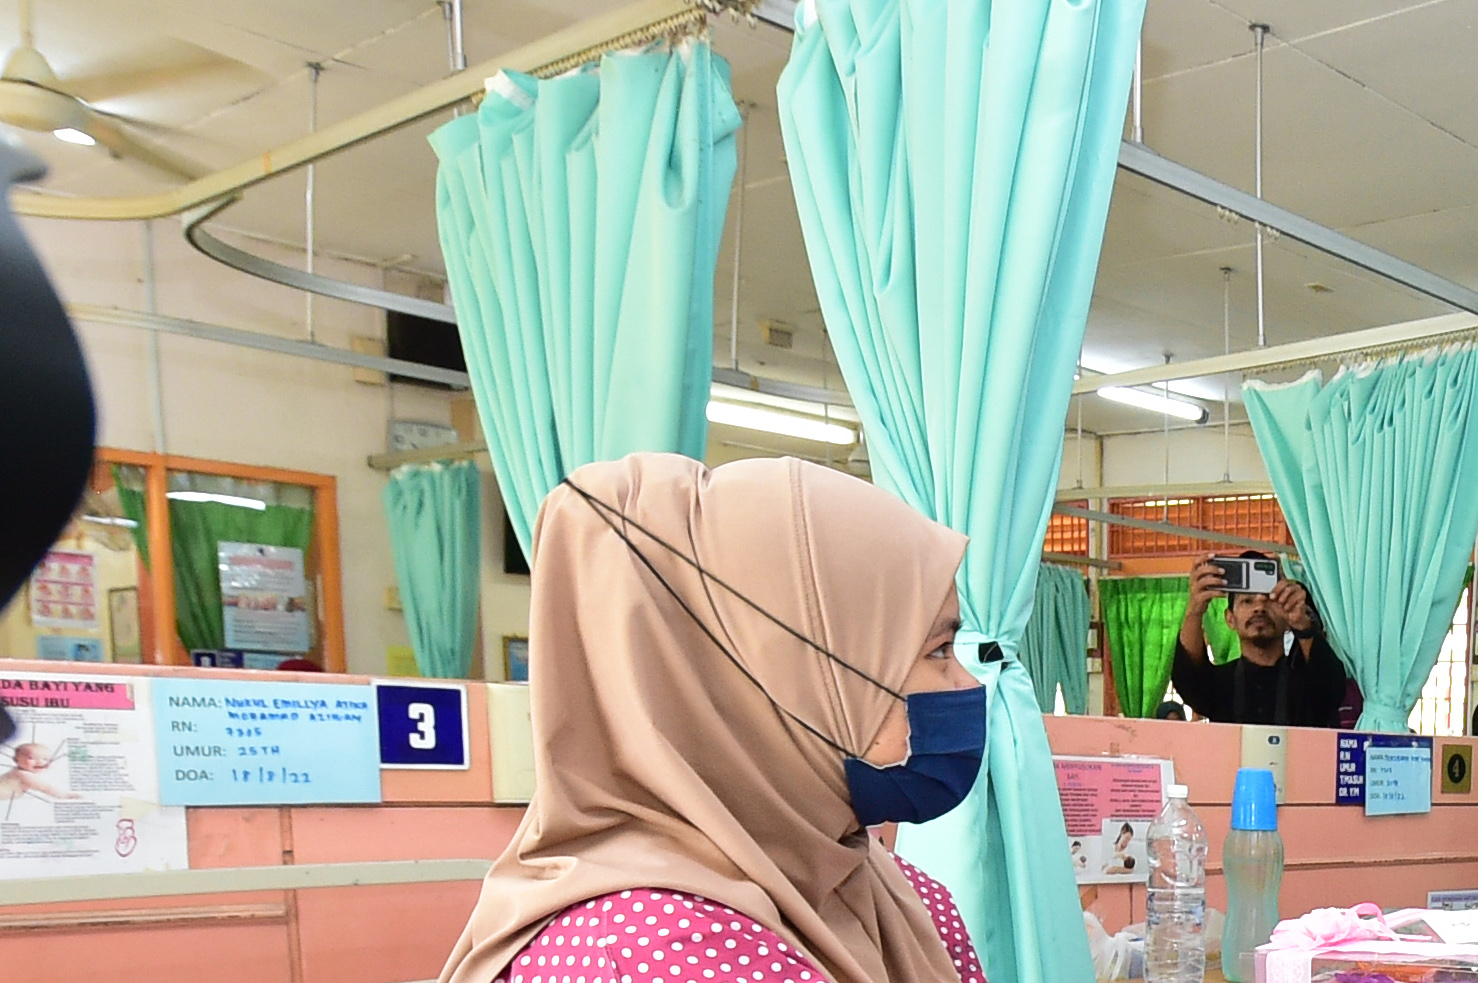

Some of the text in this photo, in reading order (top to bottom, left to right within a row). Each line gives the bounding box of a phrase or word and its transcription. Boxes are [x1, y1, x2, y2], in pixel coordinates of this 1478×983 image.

[29, 680, 67, 692] BAYI
[73, 681, 115, 694] YANG
[44, 699, 70, 709] IBU
[169, 696, 222, 709] NAMA:
[171, 720, 197, 733] RN:
[408, 702, 436, 749] 3
[173, 745, 226, 758] UMUR:
[1452, 758, 1460, 778] 4
[175, 769, 214, 782] DOA:
